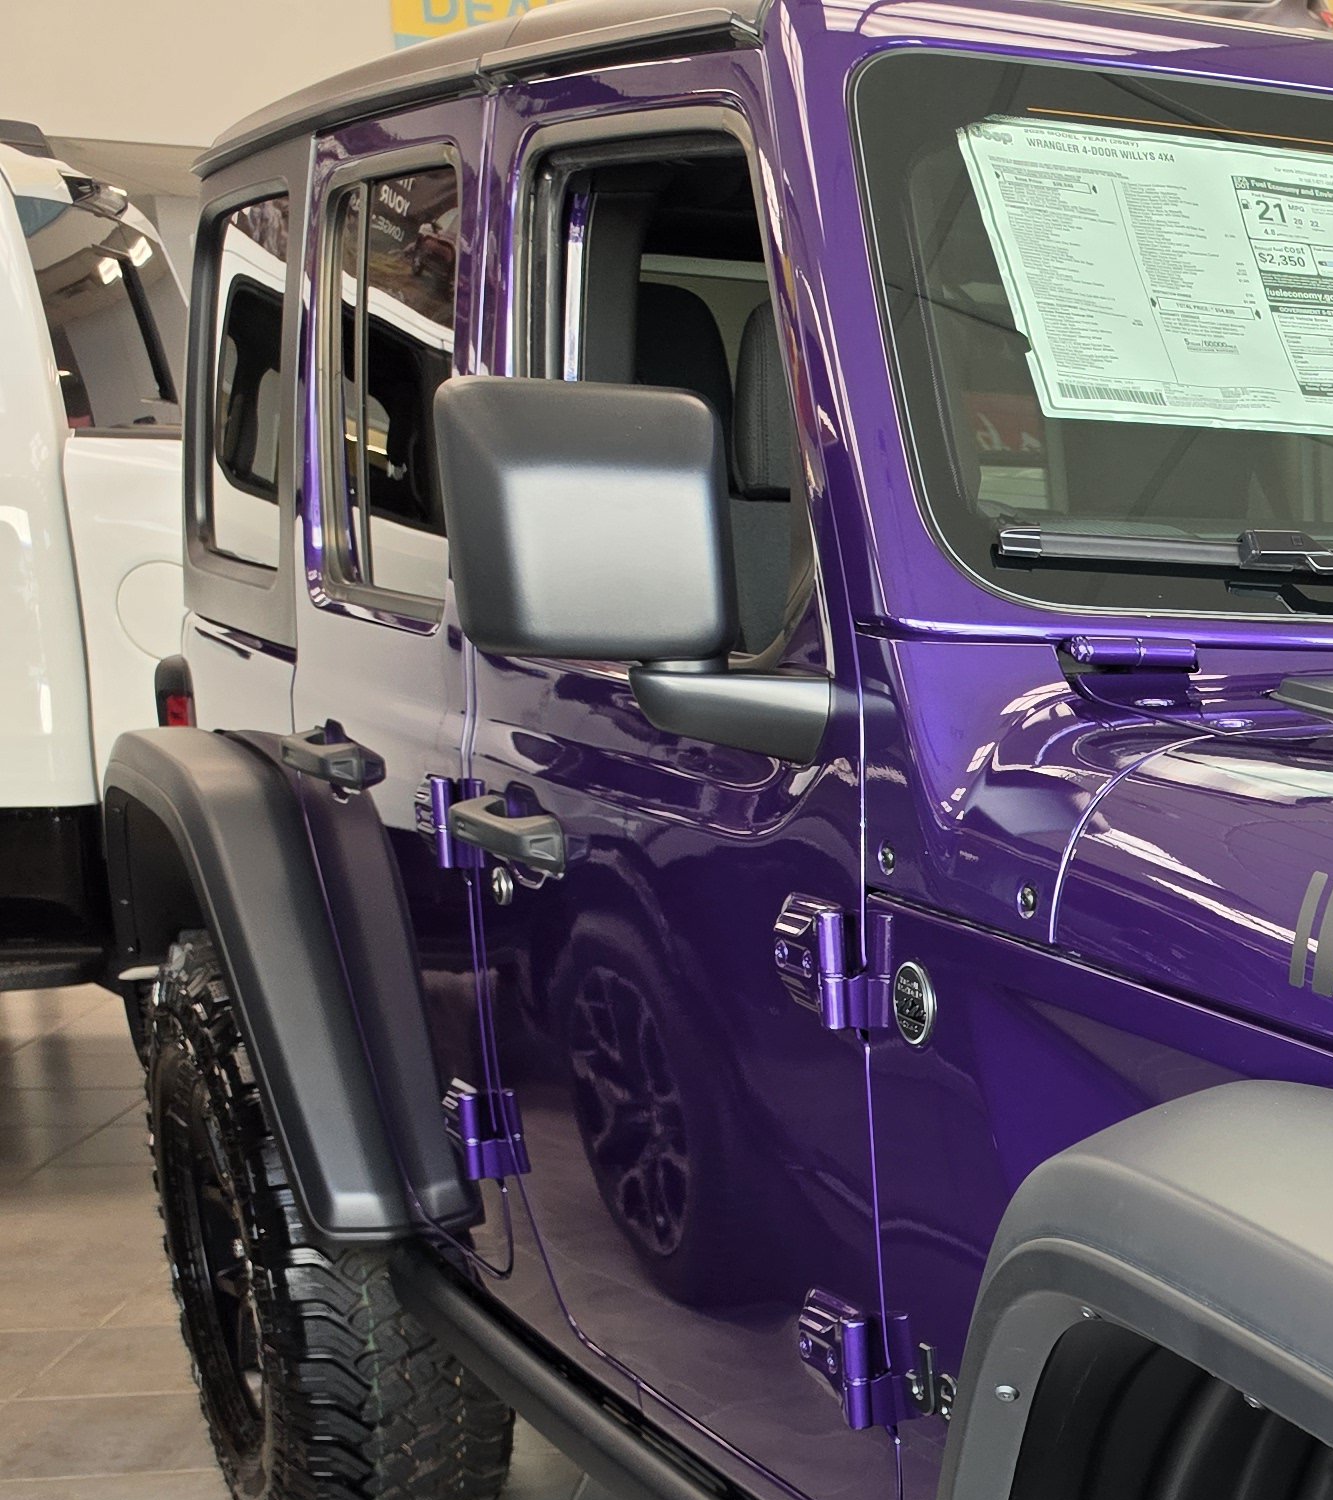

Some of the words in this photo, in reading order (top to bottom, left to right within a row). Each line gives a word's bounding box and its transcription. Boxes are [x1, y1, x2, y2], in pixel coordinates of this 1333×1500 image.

[1026, 137, 1080, 154] WRANGLER
[1081, 146, 1118, 159] 4-DOOR
[1119, 149, 1156, 162] WILLYS
[1157, 152, 1175, 163] 4X4
[1250, 180, 1267, 189] Fuel
[1267, 183, 1301, 196] Economy
[1301, 187, 1314, 196] and
[1255, 199, 1288, 224] 21
[1309, 219, 1319, 228] 22
[1284, 244, 1305, 255] cost
[1258, 251, 1307, 268] $2,350
